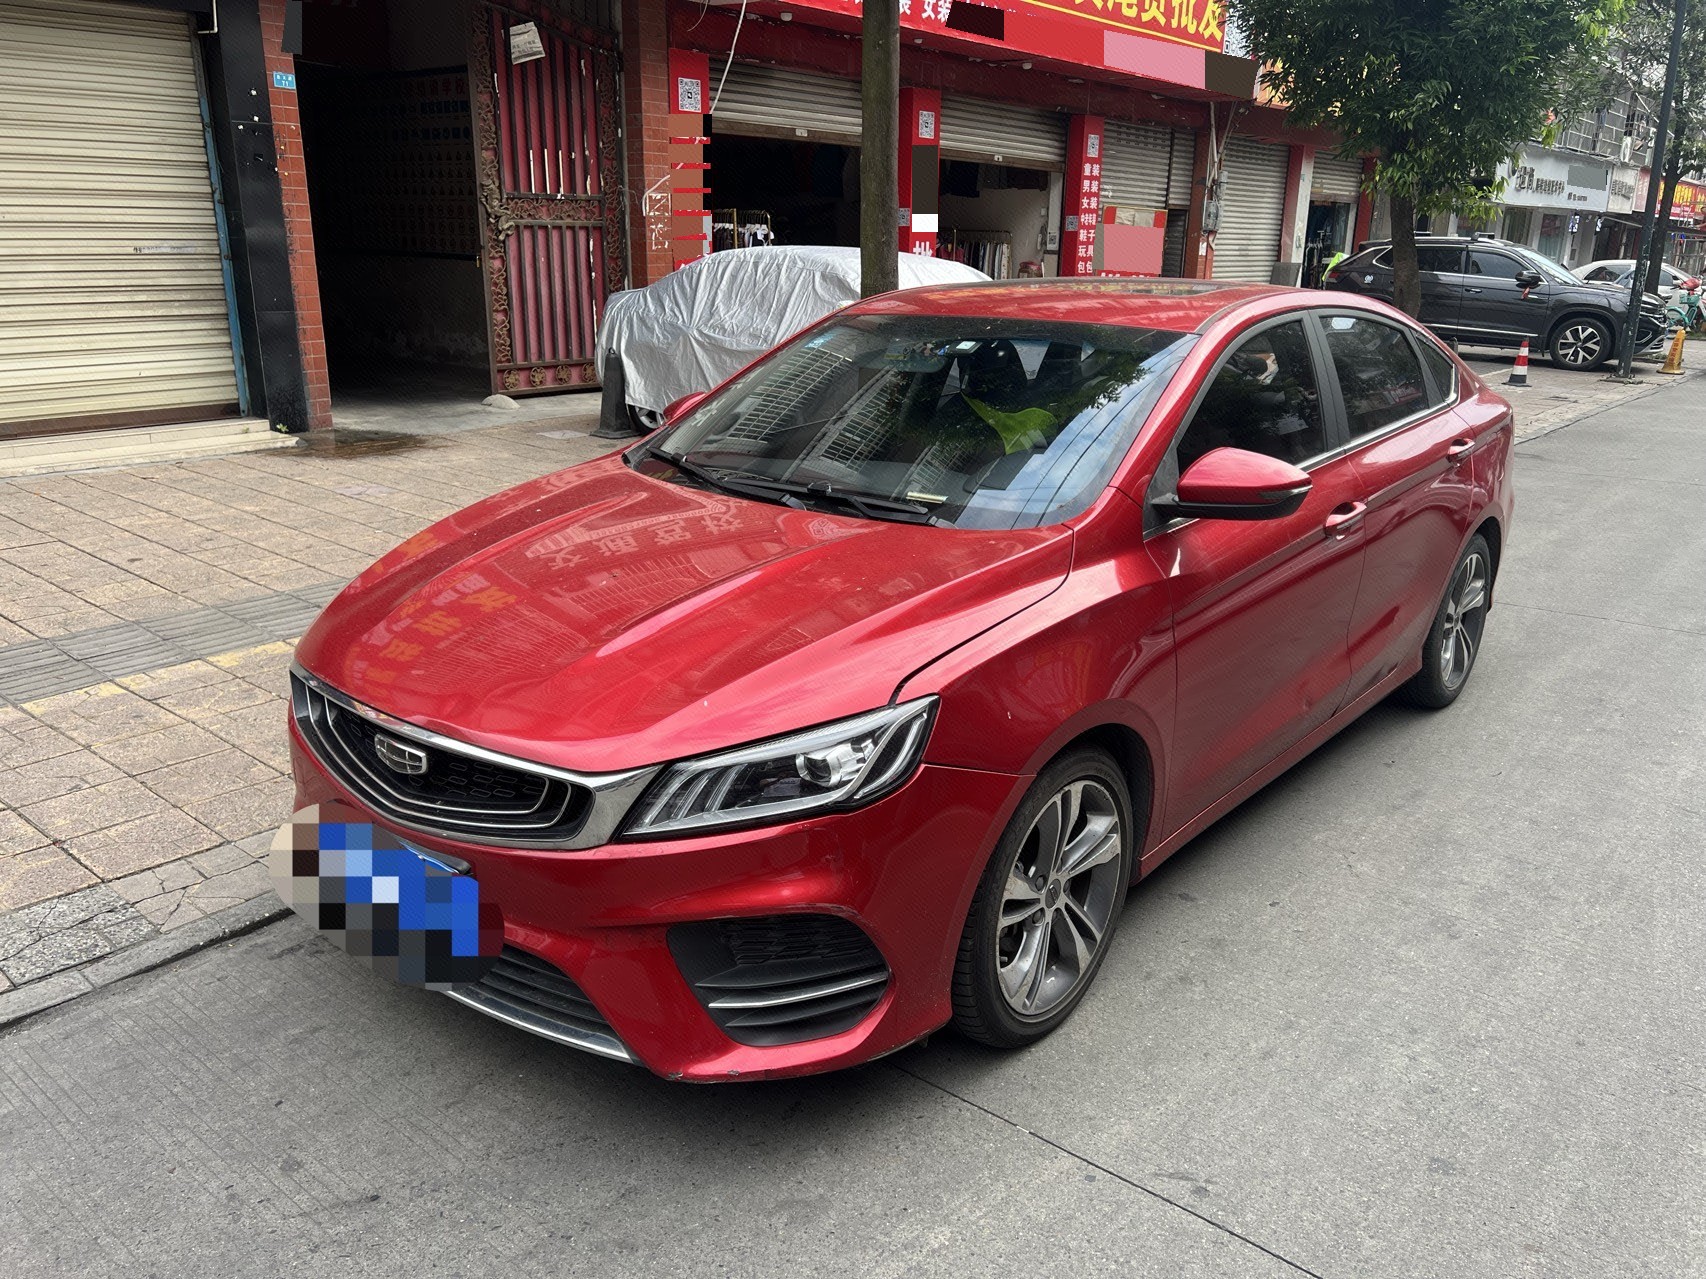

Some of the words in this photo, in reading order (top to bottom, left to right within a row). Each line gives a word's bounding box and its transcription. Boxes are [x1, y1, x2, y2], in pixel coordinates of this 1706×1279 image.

[1083, 163, 1100, 177] 童装
[1082, 179, 1099, 193] 男装
[1081, 196, 1098, 209] 女装
[1079, 229, 1095, 242] 鞋子
[1078, 244, 1094, 257] 玩具
[1077, 260, 1093, 274] 包包
